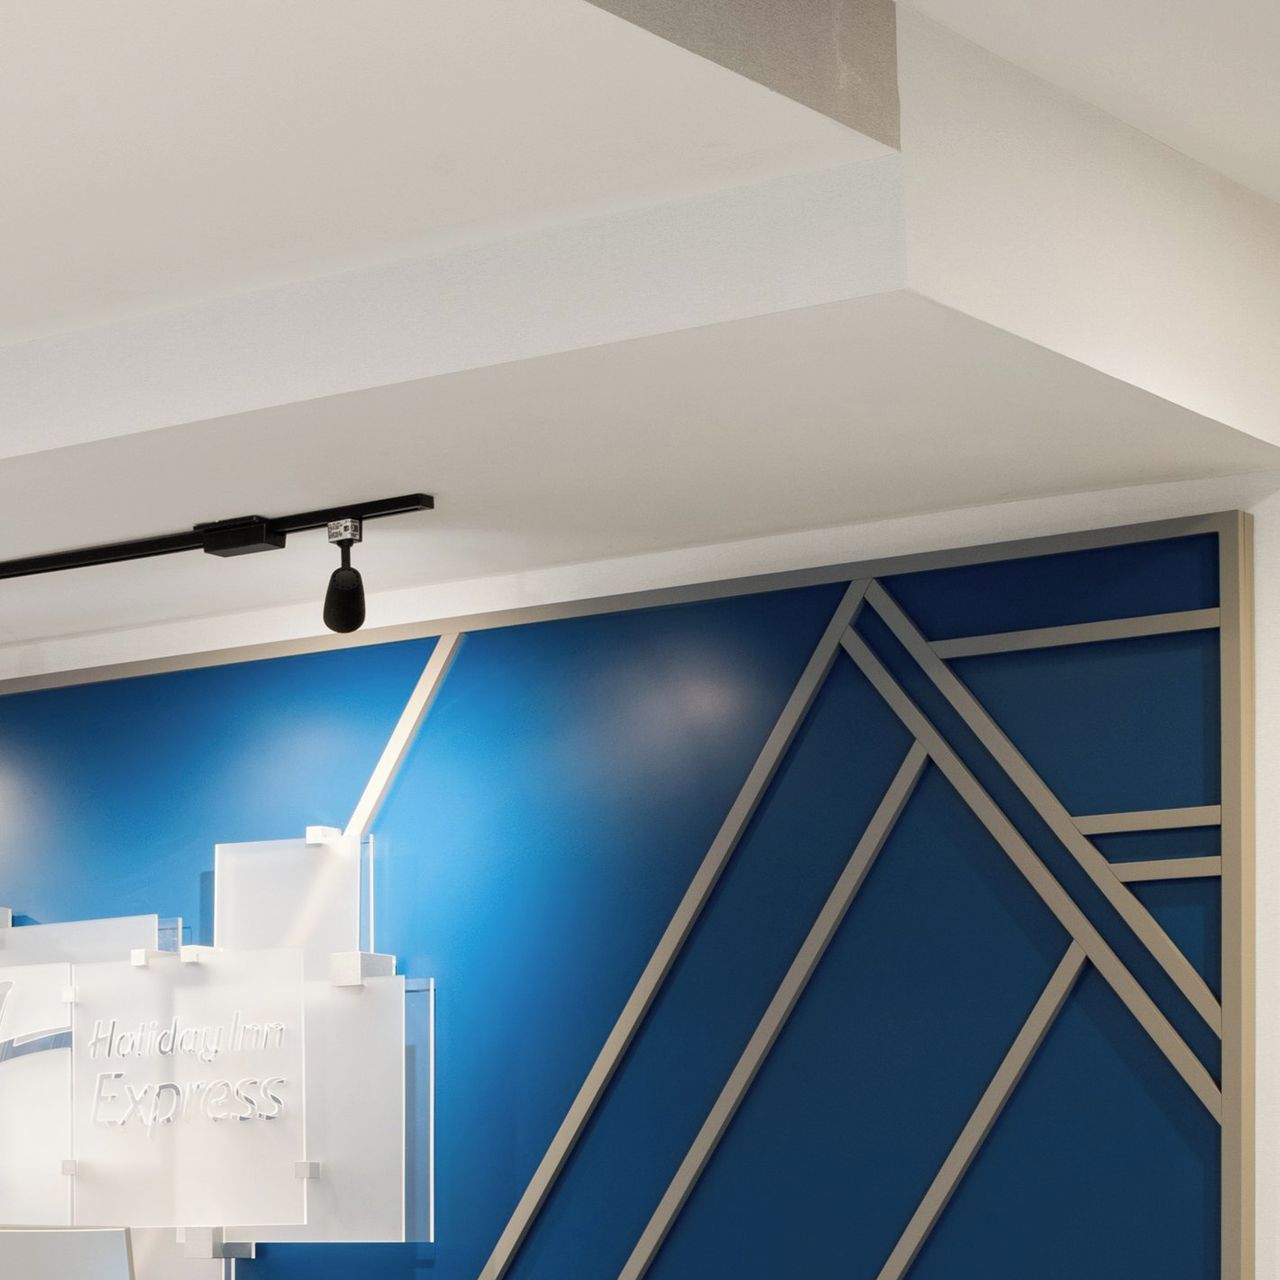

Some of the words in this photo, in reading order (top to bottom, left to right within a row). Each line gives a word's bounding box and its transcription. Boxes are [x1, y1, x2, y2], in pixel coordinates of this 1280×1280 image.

[88, 1014, 224, 1063] Holiday
[227, 1010, 285, 1050] Inn
[92, 1072, 288, 1138] Express
